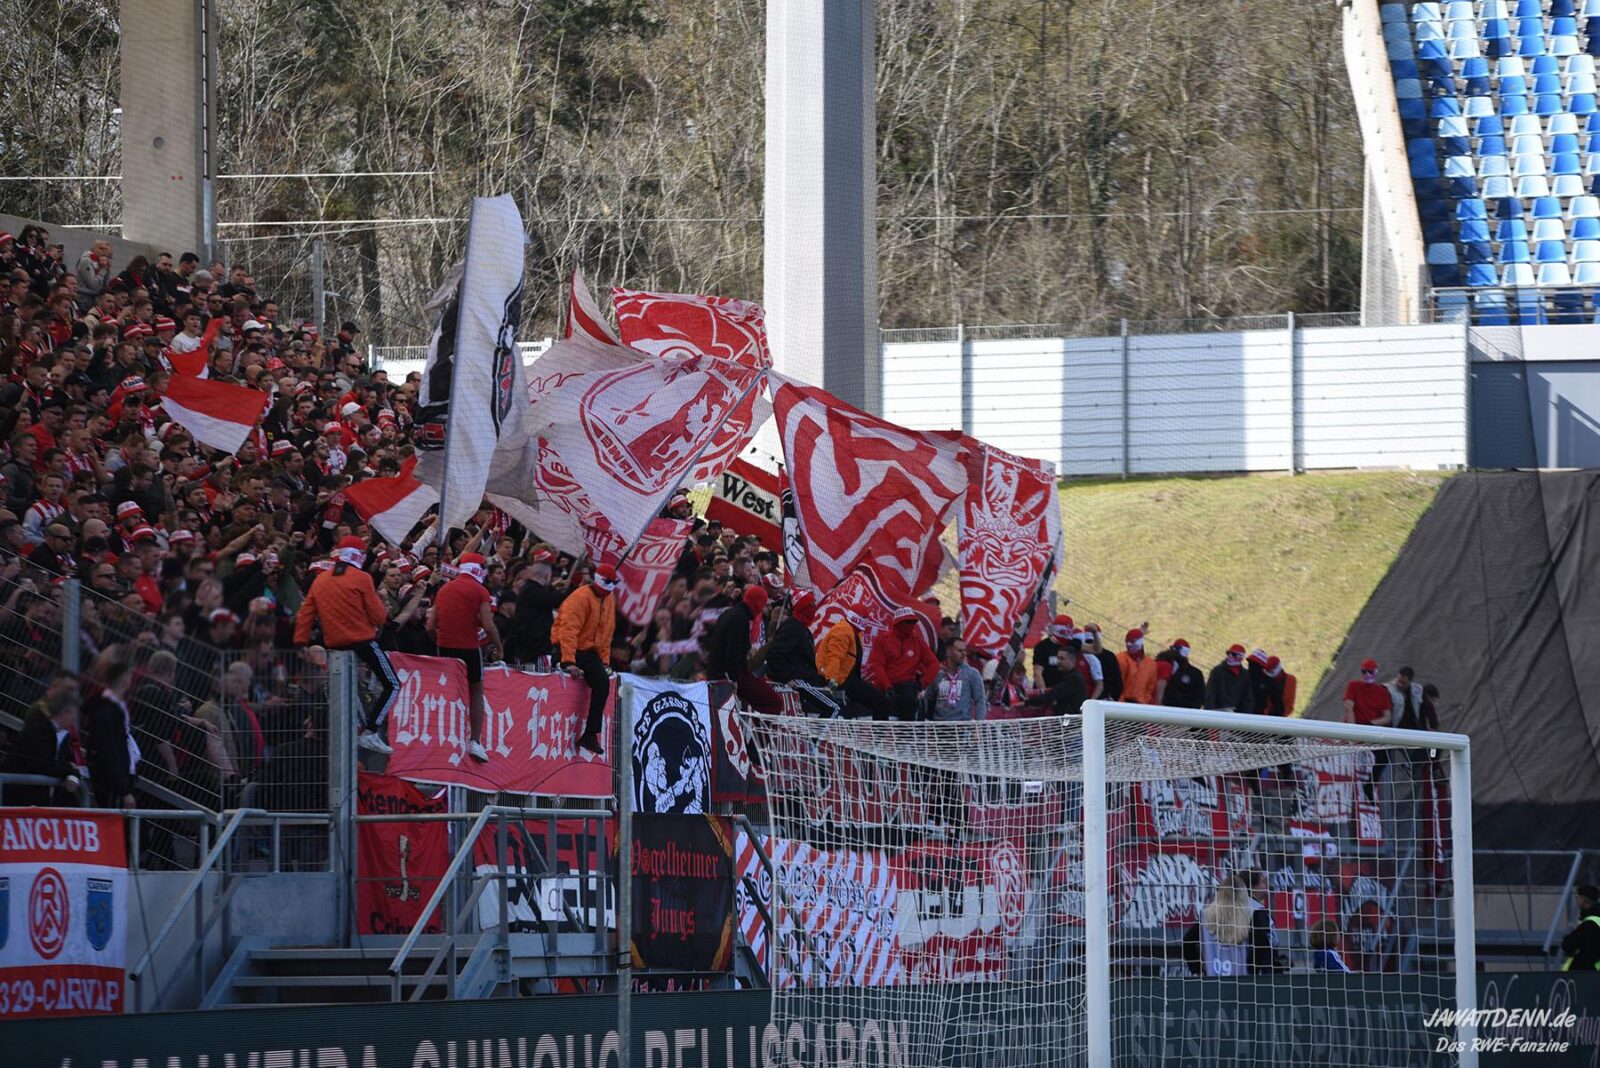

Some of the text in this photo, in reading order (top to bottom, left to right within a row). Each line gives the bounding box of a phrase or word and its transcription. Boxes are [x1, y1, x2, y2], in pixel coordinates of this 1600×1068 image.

[723, 472, 774, 519] West
[394, 668, 514, 766] Brigde
[653, 696, 689, 714] GARDE
[0, 817, 100, 852] ANCLUB
[651, 897, 697, 941] Jungs
